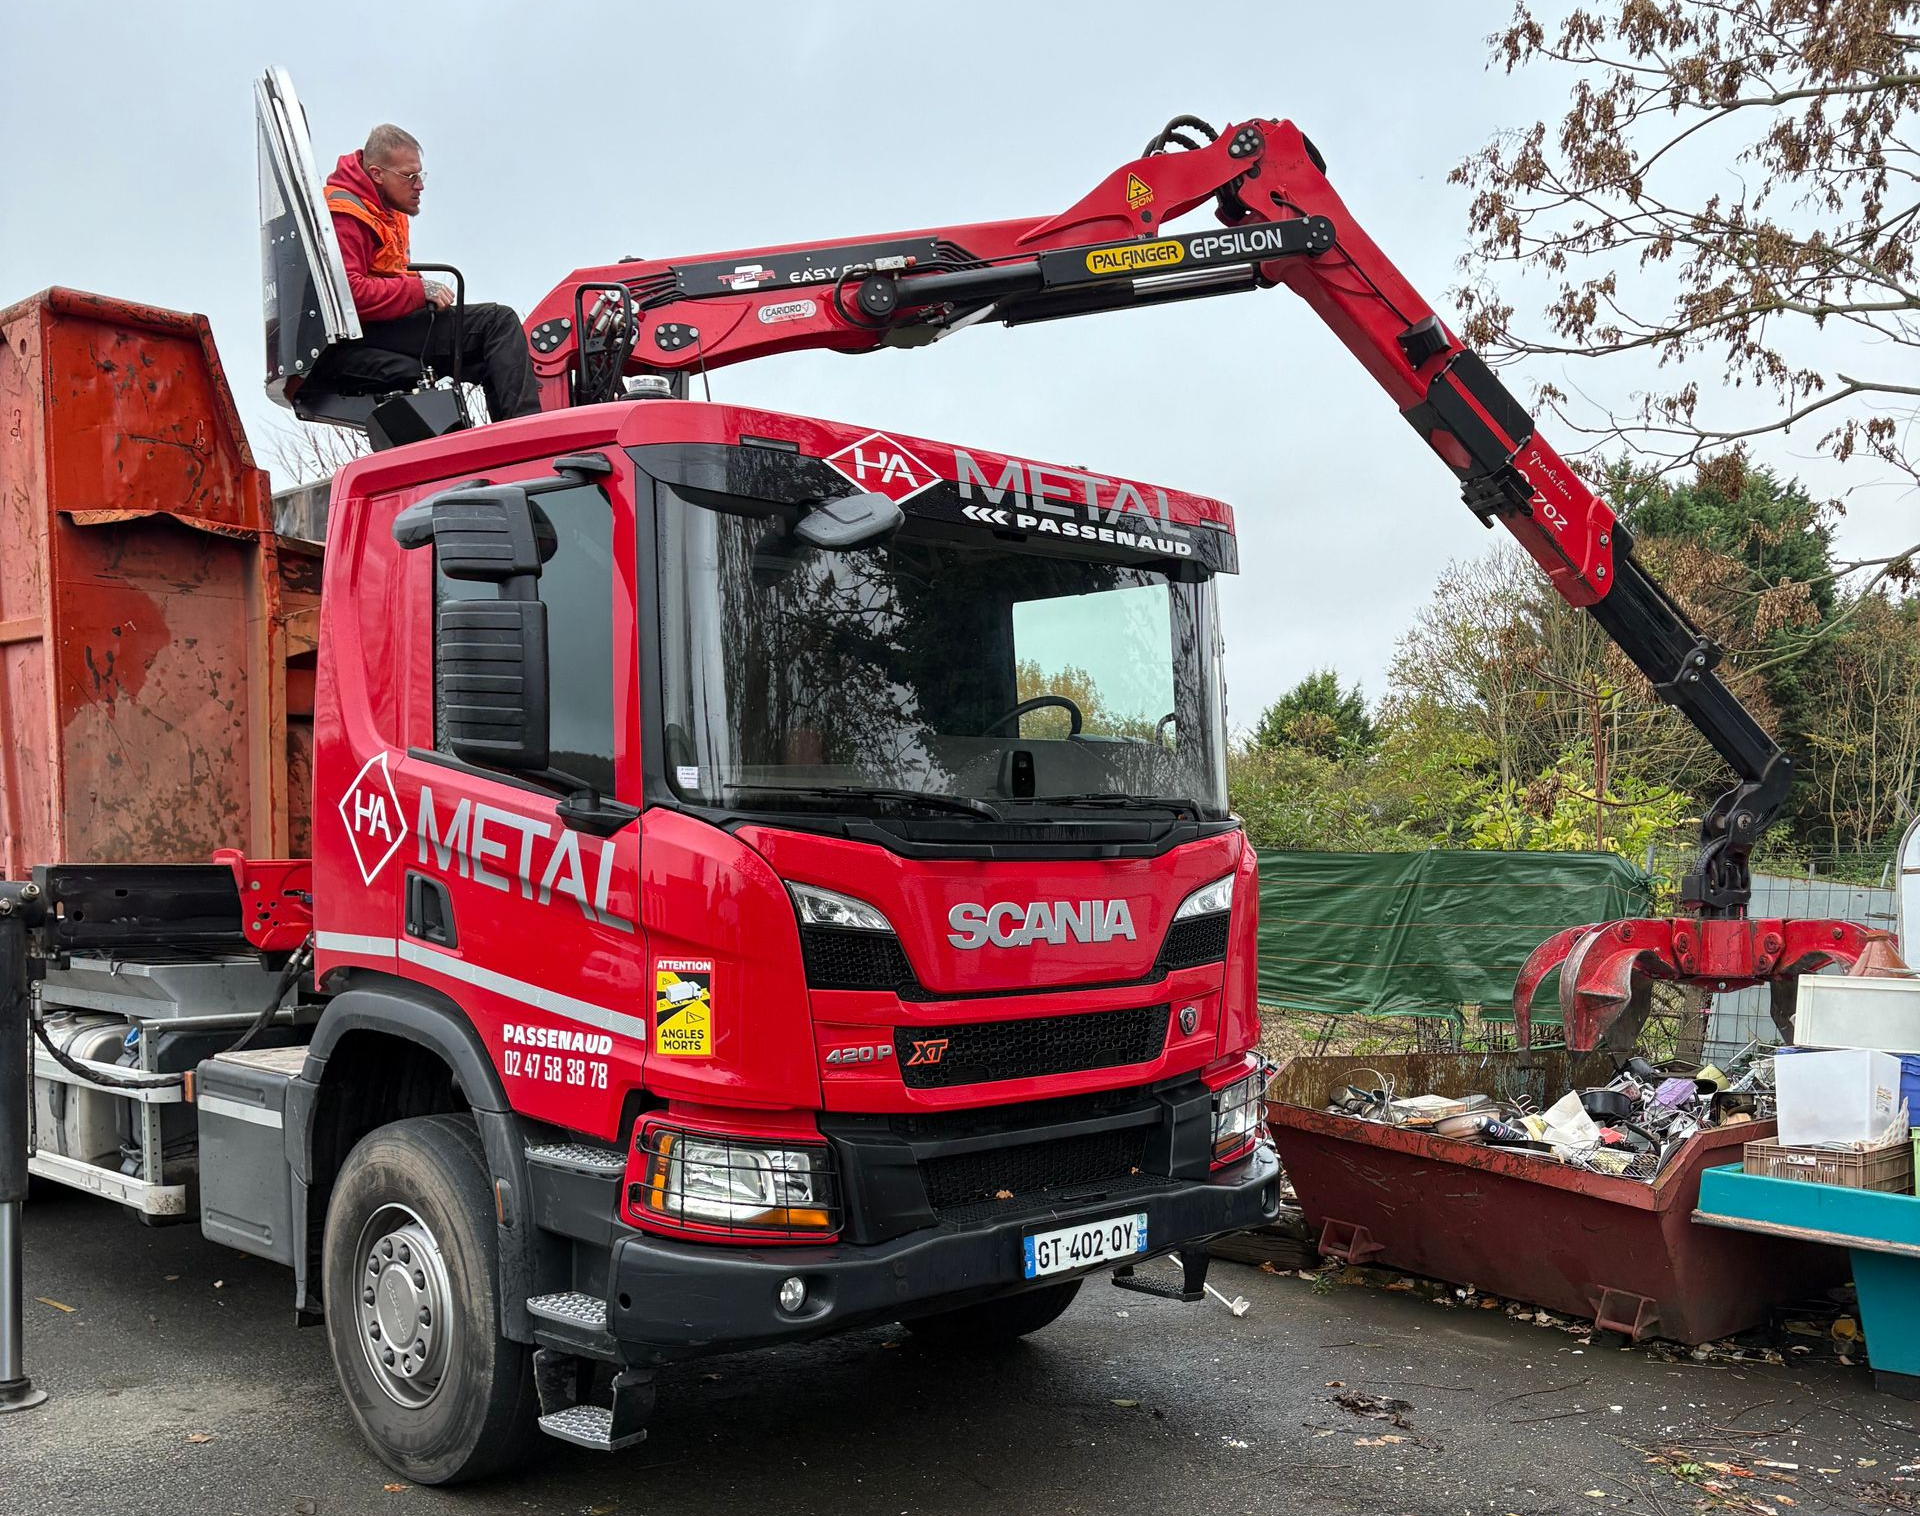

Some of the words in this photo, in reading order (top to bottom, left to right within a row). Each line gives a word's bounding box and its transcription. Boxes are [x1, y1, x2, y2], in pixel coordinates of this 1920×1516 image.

[1131, 195, 1154, 210] 20M
[1092, 245, 1179, 269] PALFINGER
[1189, 228, 1283, 259] EPSILON
[789, 266, 837, 283] EASY
[854, 447, 920, 488] HA
[954, 449, 1190, 538] METAL
[1016, 513, 1192, 556] PASSENAUD
[354, 788, 392, 843] HA
[417, 785, 635, 934] METAL
[947, 899, 1137, 950] SCANIA
[657, 960, 711, 971] ATTENTION
[503, 1023, 613, 1056] PASSENAUD
[661, 1028, 704, 1040] ANGLES
[663, 1040, 702, 1051] MORTS
[826, 1046, 874, 1064] 420
[877, 1044, 893, 1060] P
[906, 1038, 949, 1066] XT
[504, 1049, 521, 1077] 02
[524, 1052, 540, 1080] 47
[544, 1055, 562, 1082] 58
[566, 1058, 585, 1086] 38
[589, 1061, 608, 1090] 78
[1137, 1232, 1147, 1248] 37
